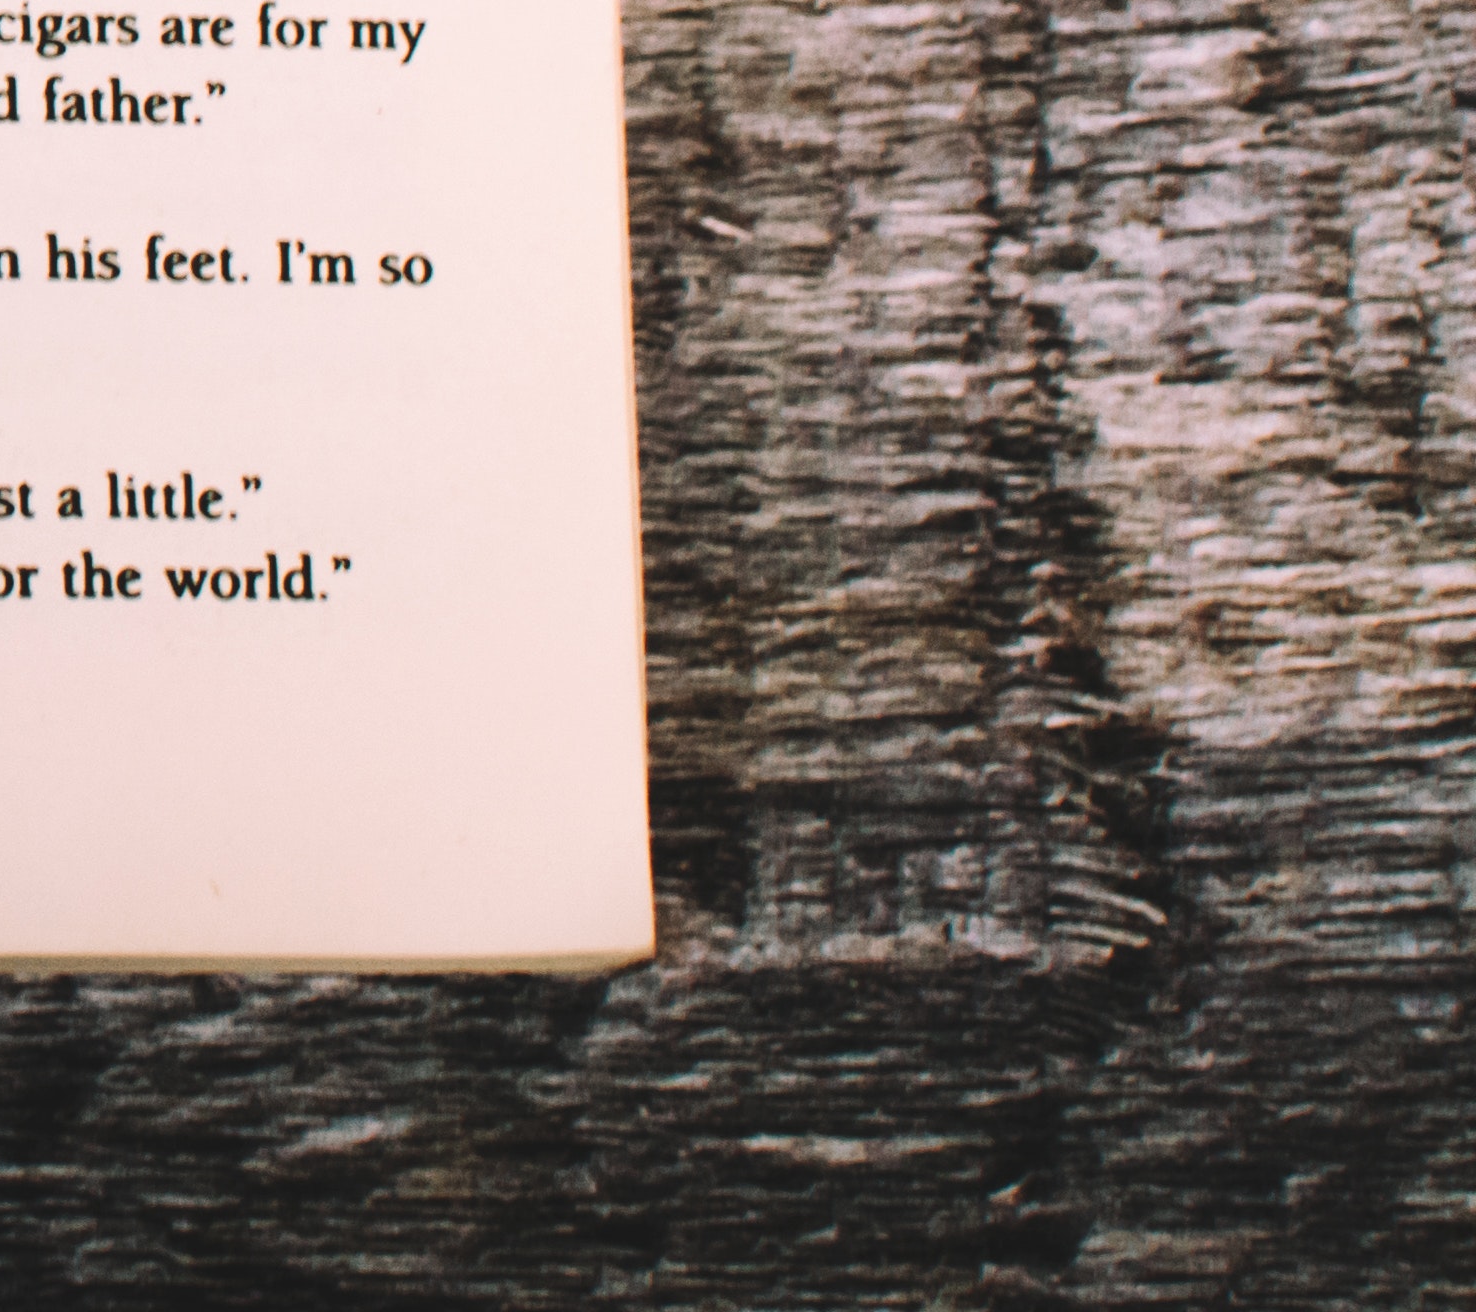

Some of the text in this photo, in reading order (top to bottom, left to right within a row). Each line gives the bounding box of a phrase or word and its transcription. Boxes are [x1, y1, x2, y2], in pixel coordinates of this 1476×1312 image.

[44, 74, 226, 125] father.”
[62, 550, 142, 600] the
[164, 552, 351, 602] world.”
